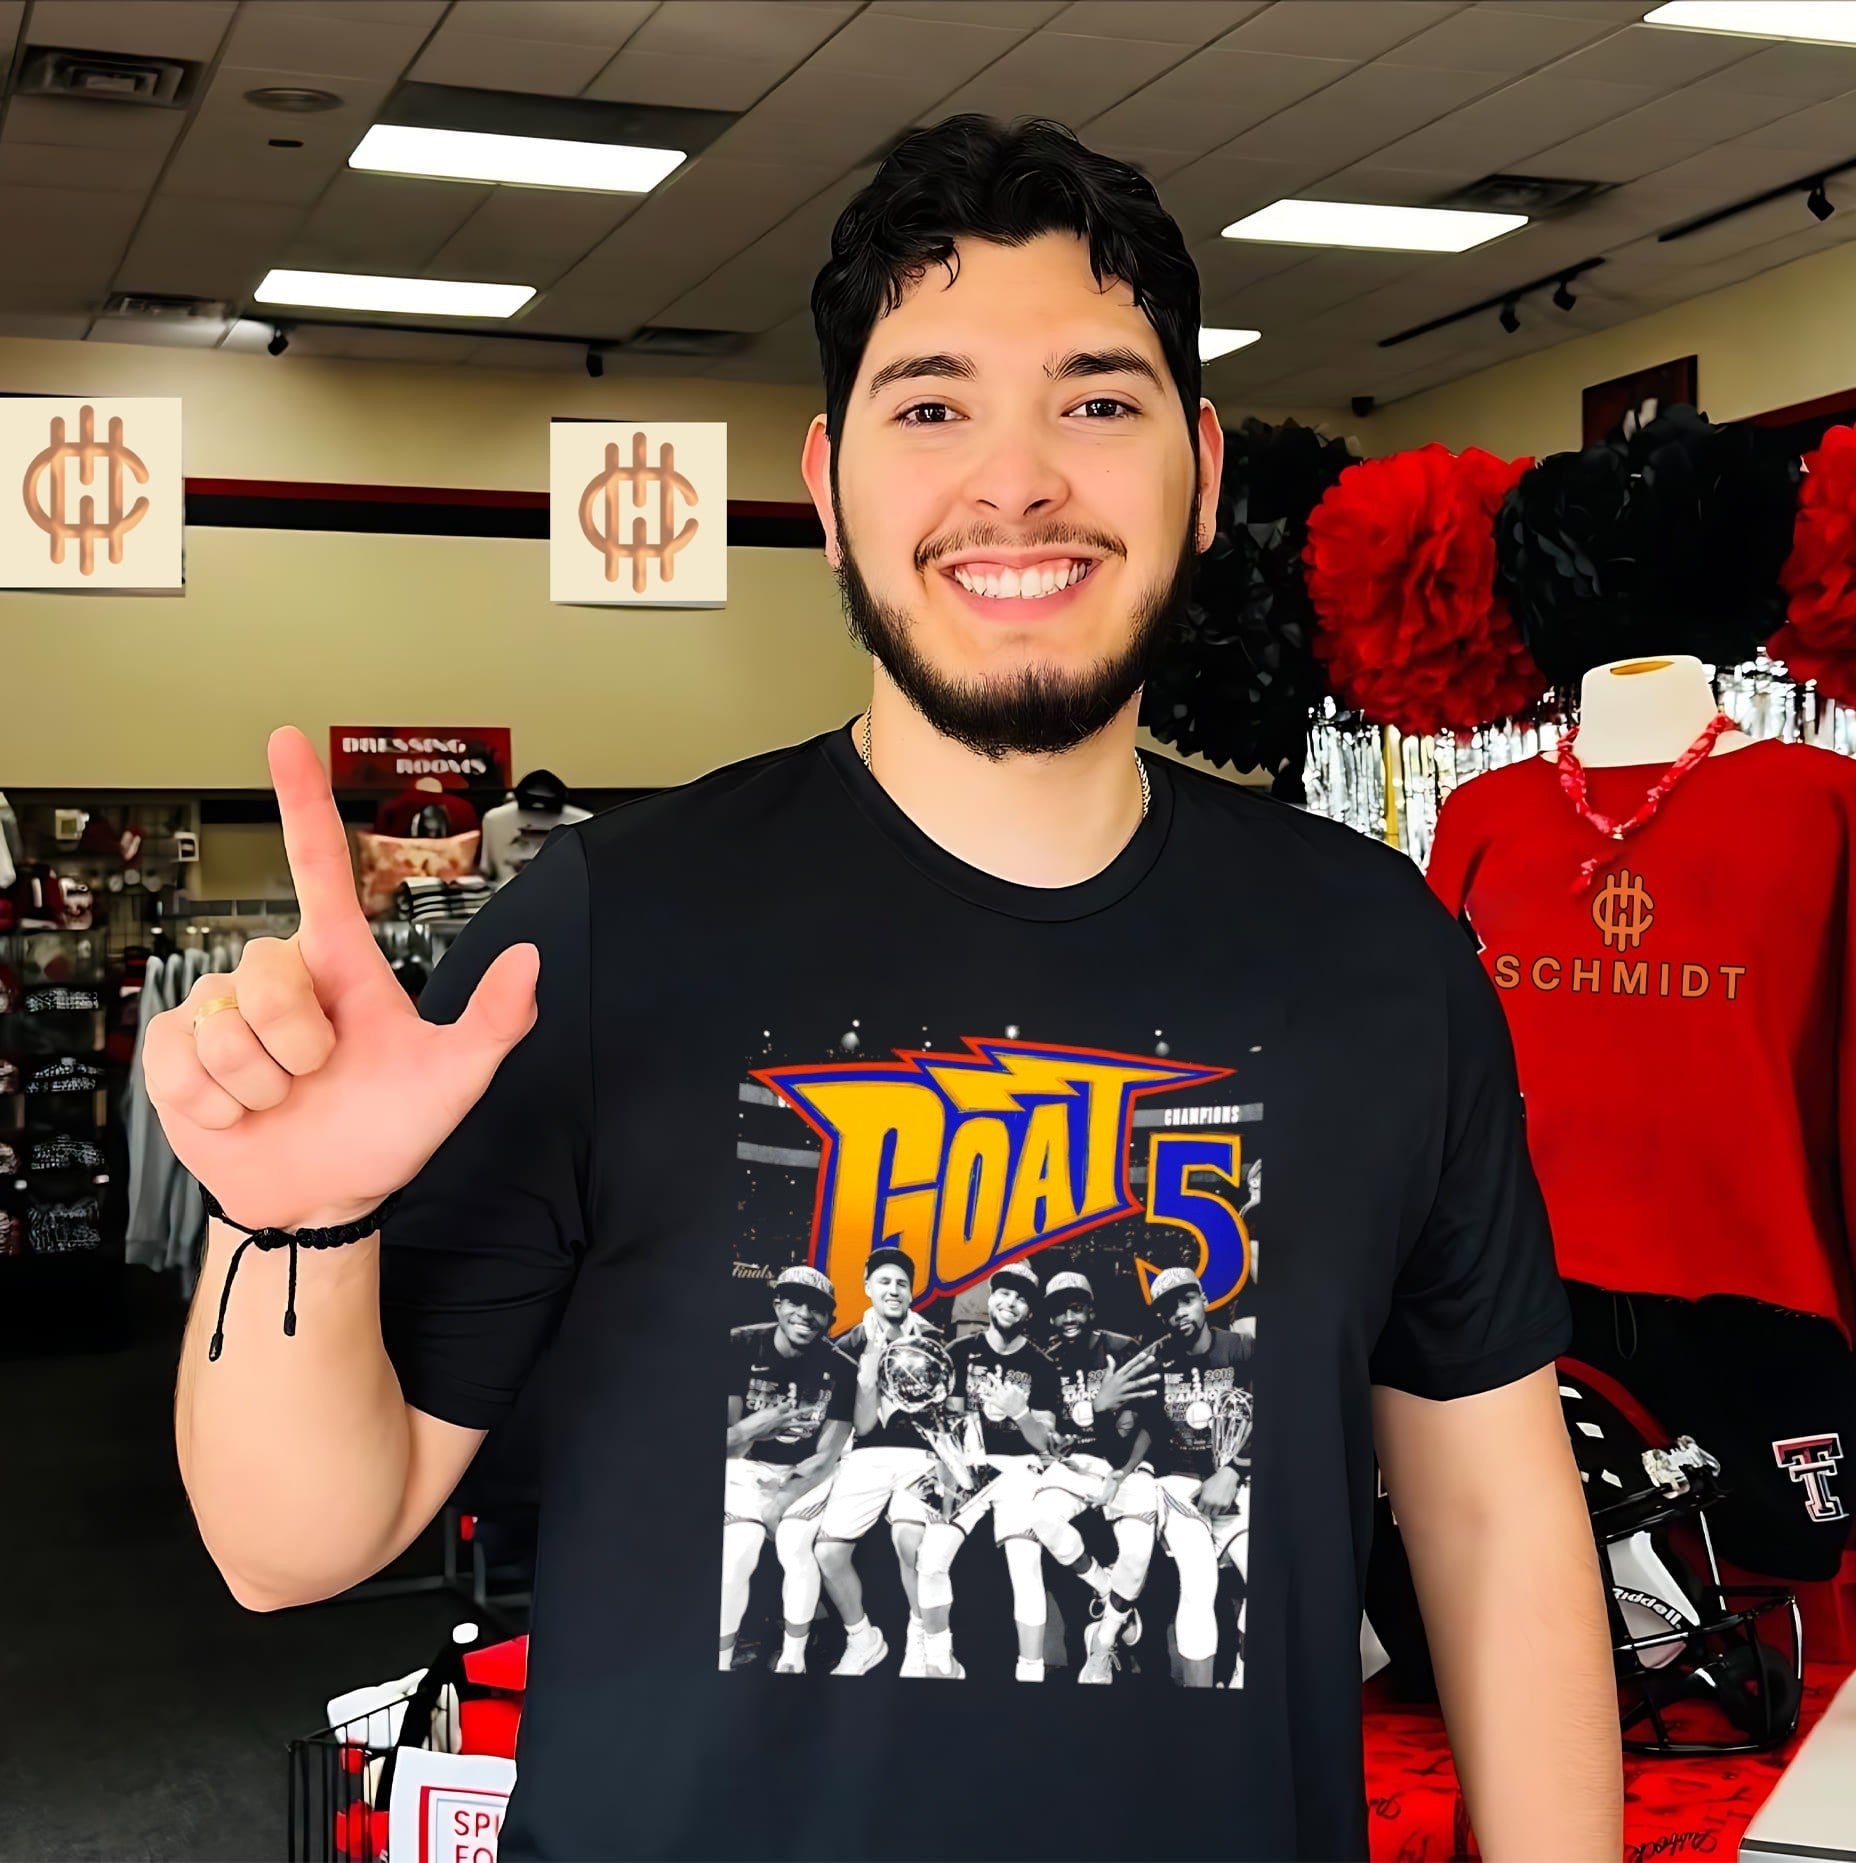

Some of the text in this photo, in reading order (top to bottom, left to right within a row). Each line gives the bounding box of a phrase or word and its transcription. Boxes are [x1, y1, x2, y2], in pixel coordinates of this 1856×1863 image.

[342, 737, 467, 753] DRESSING
[396, 758, 487, 774] ROOMS
[1494, 954, 1747, 1000] SCHMIDT
[1164, 1105, 1240, 1126] CHAMPIONS
[766, 1044, 1253, 1336] GOAT 5
